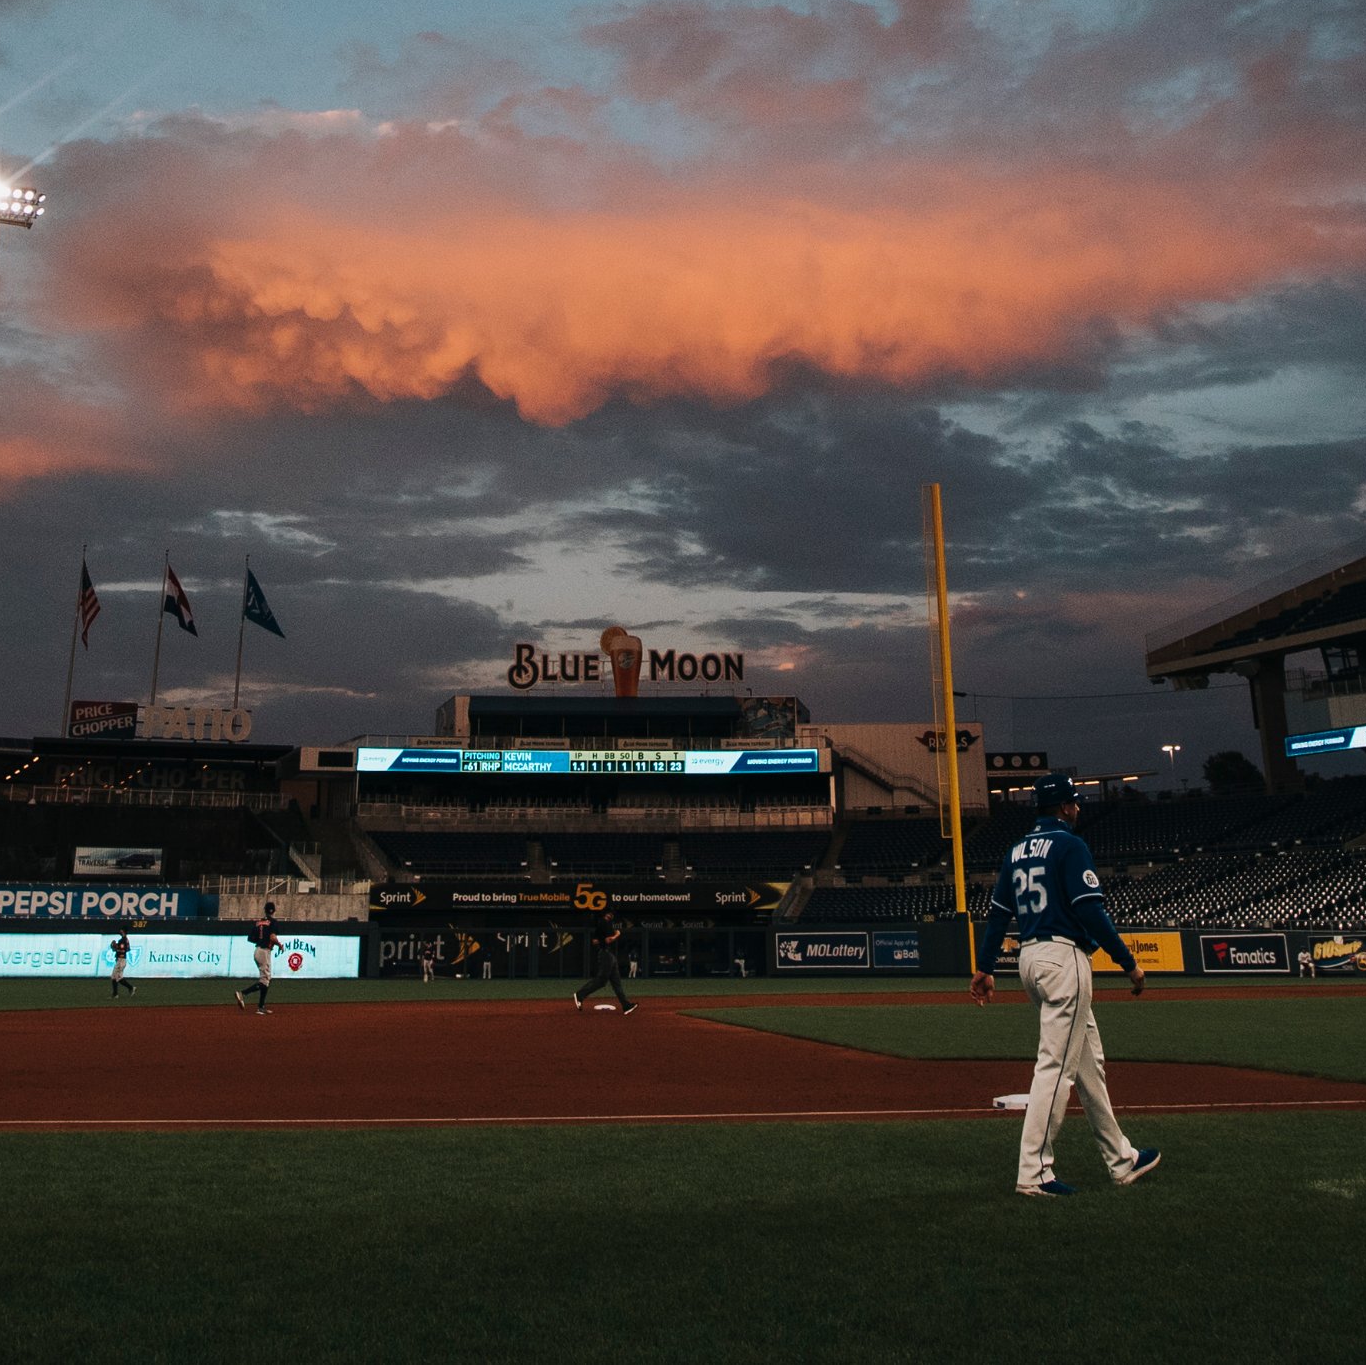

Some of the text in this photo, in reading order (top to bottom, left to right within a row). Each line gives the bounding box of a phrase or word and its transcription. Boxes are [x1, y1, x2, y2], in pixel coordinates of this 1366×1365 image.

[507, 643, 744, 691] BLUE MOON
[75, 704, 113, 720] PRICE
[72, 716, 134, 736] CHOPPER
[141, 706, 252, 742] PATIO
[464, 752, 501, 761] PITCHING
[504, 752, 532, 761] KEVIN
[574, 751, 679, 760] IP BB SO B S T
[698, 757, 725, 767] evergy
[464, 762, 501, 771] #61 RHP
[504, 762, 552, 772] MCCARTHY
[572, 761, 682, 771] 1.1 11 12 23
[1010, 838, 1054, 864] WILSON
[452, 892, 480, 902] Proud
[481, 893, 490, 902] to
[492, 892, 517, 904] bring
[574, 882, 608, 911] 5G
[611, 893, 620, 902] to
[639, 892, 691, 902] hometown!
[715, 891, 746, 904] Sprint
[1012, 865, 1048, 915] 25
[81, 891, 179, 916] PORCH
[379, 891, 411, 906] Sprint
[133, 920, 147, 928] 387
[293, 937, 316, 958] BEAM
[806, 944, 866, 960] MOLottery
[148, 950, 222, 966] Kansas City
[1230, 947, 1276, 965] Fanatics
